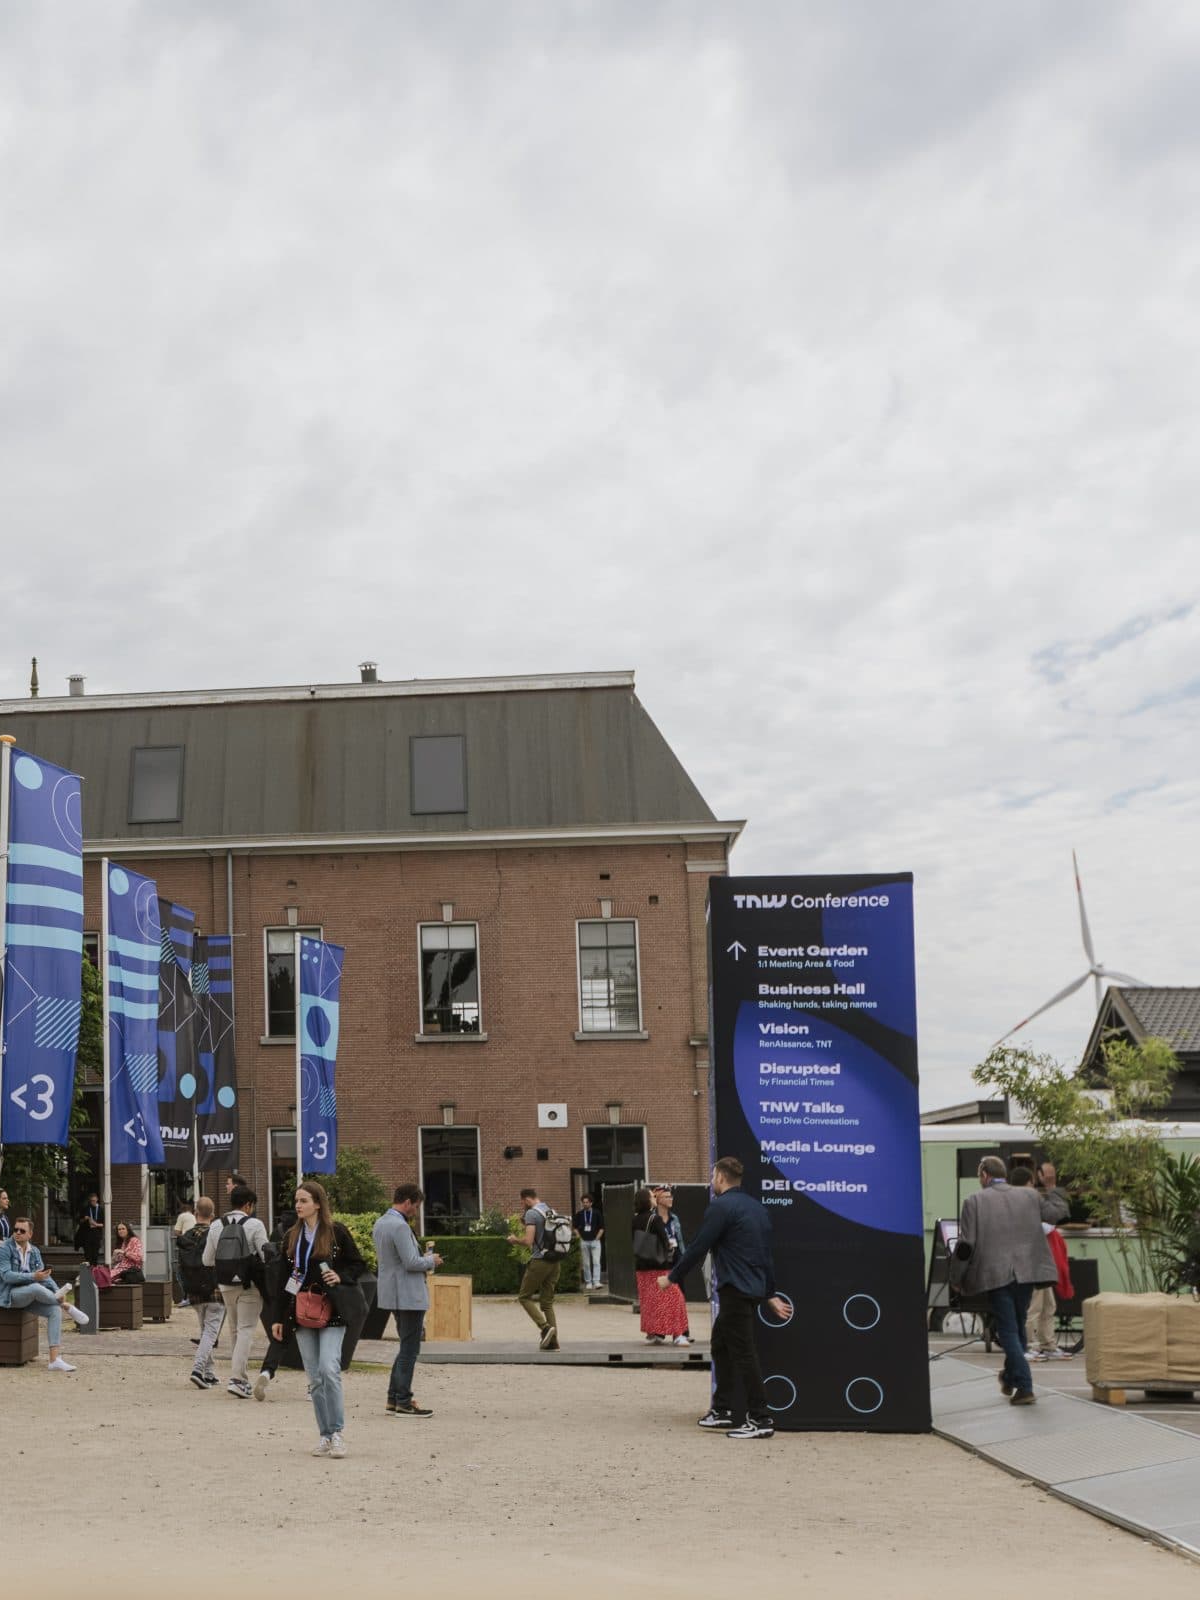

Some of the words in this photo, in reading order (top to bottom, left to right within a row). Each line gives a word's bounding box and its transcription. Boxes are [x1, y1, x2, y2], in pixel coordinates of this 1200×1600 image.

[734, 894, 788, 909] TNW
[790, 893, 890, 909] Conference
[757, 946, 805, 957] Event
[806, 945, 869, 957] Garden
[757, 960, 768, 968] 1:1
[769, 960, 803, 970] Meeting
[804, 960, 824, 968] Area
[825, 960, 832, 968] &
[833, 959, 855, 968] Food
[758, 984, 831, 996] Business
[833, 983, 865, 995] Hall
[758, 1000, 792, 1010] Shaking
[792, 1000, 821, 1009] hands,
[821, 1000, 848, 1010] taking
[849, 1001, 878, 1009] names
[758, 1023, 809, 1035] Vision
[815, 1040, 832, 1048] TNT
[759, 1063, 841, 1077] Disrupted
[759, 1078, 770, 1087] by
[771, 1078, 808, 1086] Financial
[809, 1078, 835, 1086] Times
[10, 1073, 55, 1121] <3
[759, 1101, 799, 1113] TNW
[801, 1102, 845, 1114] Talks
[759, 1117, 782, 1126] Deep
[783, 1117, 802, 1125] Dive
[803, 1117, 859, 1126] Convesations
[160, 1126, 190, 1140] NW
[202, 1133, 234, 1145] TNW
[760, 1140, 811, 1153] Media
[813, 1141, 876, 1155] Lounge
[760, 1155, 771, 1164] by
[772, 1155, 800, 1165] Clarity
[761, 1179, 791, 1191] DEI
[792, 1180, 868, 1193] Coalition
[761, 1197, 793, 1206] Lounge
